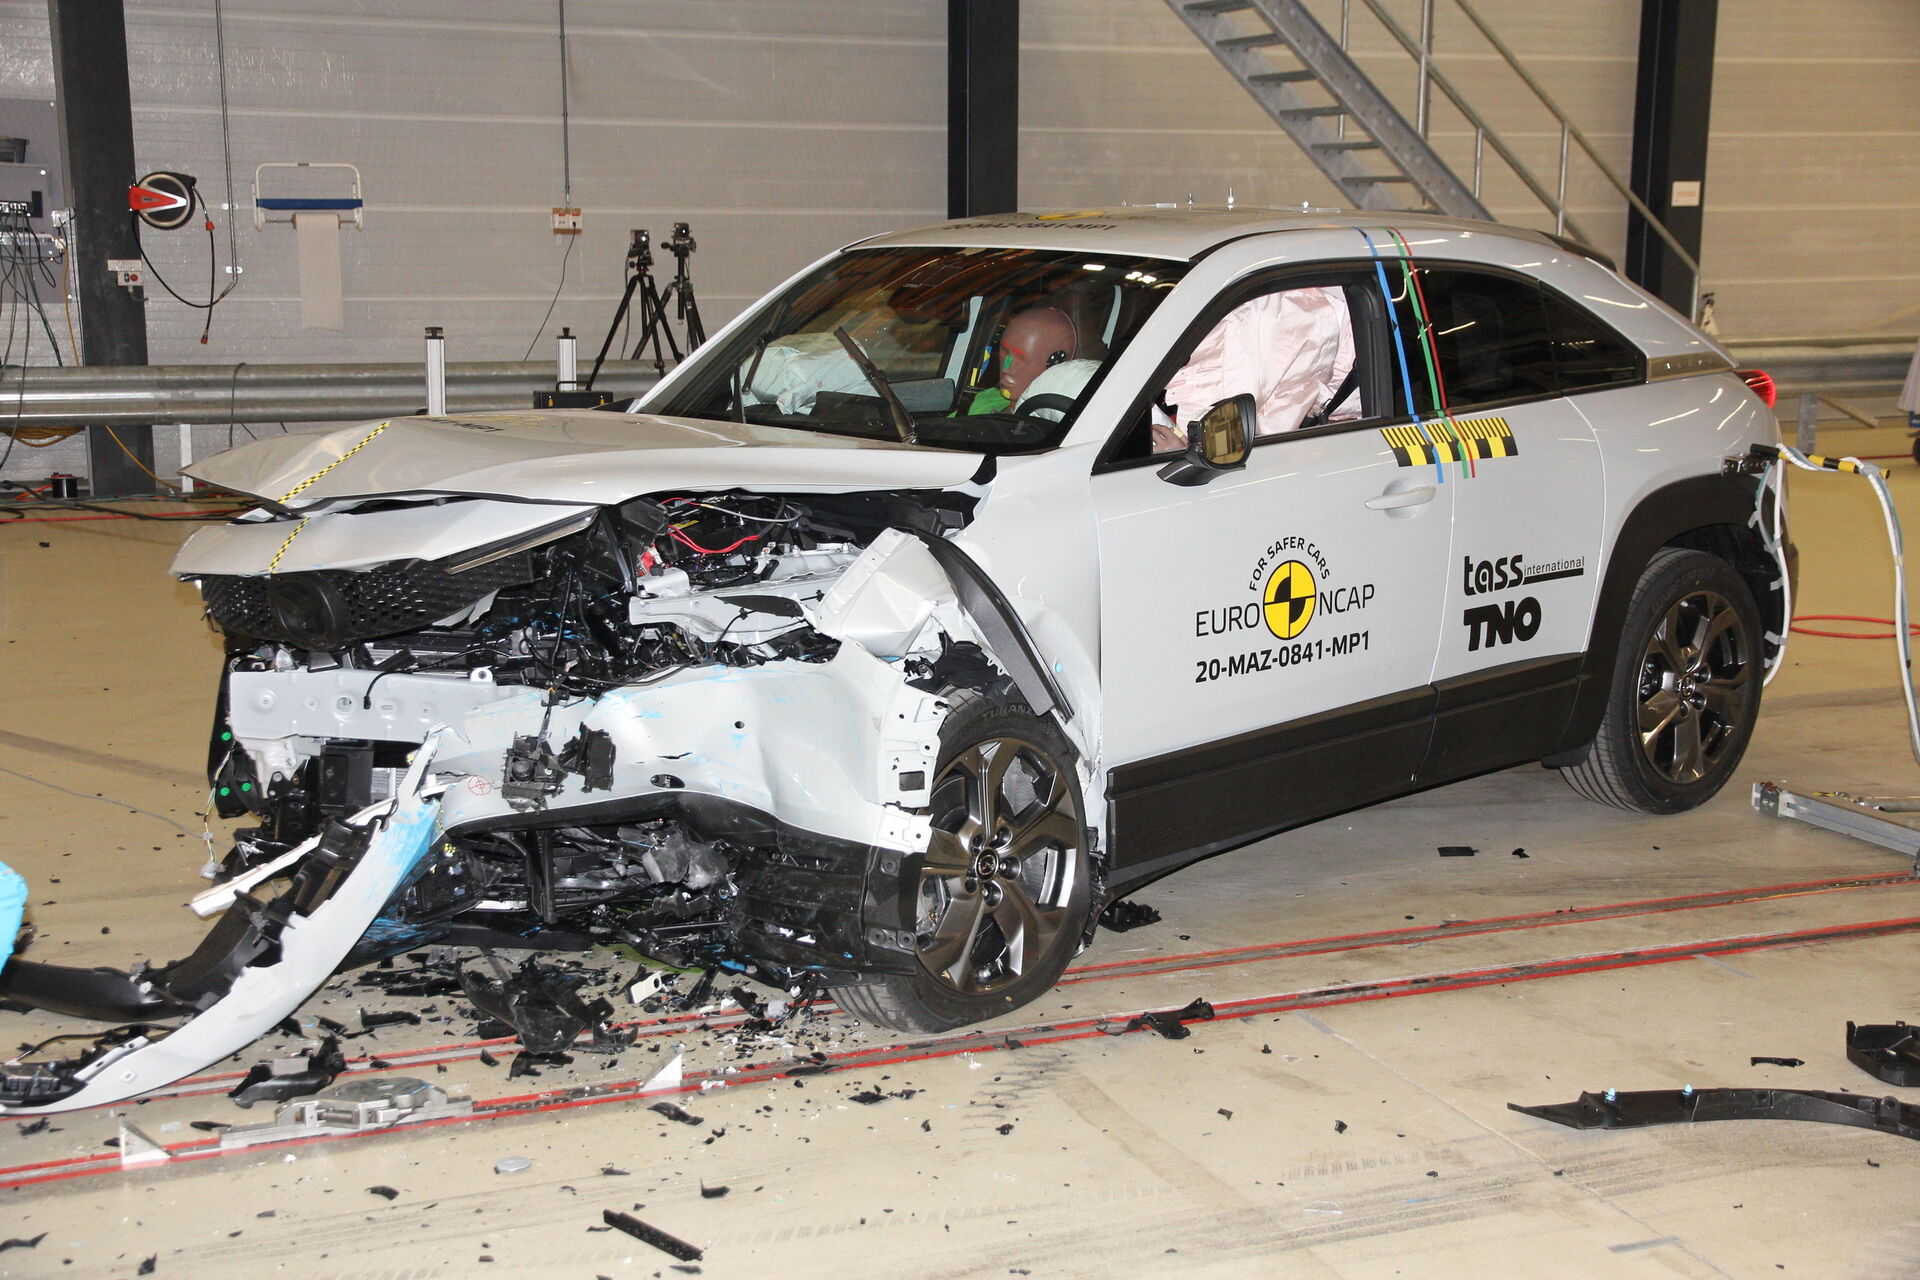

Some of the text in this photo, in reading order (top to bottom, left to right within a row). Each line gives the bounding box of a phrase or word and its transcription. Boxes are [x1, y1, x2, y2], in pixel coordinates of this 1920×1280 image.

[1248, 536, 1331, 592] FOR SAFER CARS
[1523, 556, 1585, 577] international
[1195, 583, 1376, 638] EURO NCAP
[1463, 596, 1542, 652] TNO
[1195, 629, 1370, 684] 20-MAZ-0841-MP1
[981, 704, 1035, 720] TURANZ
